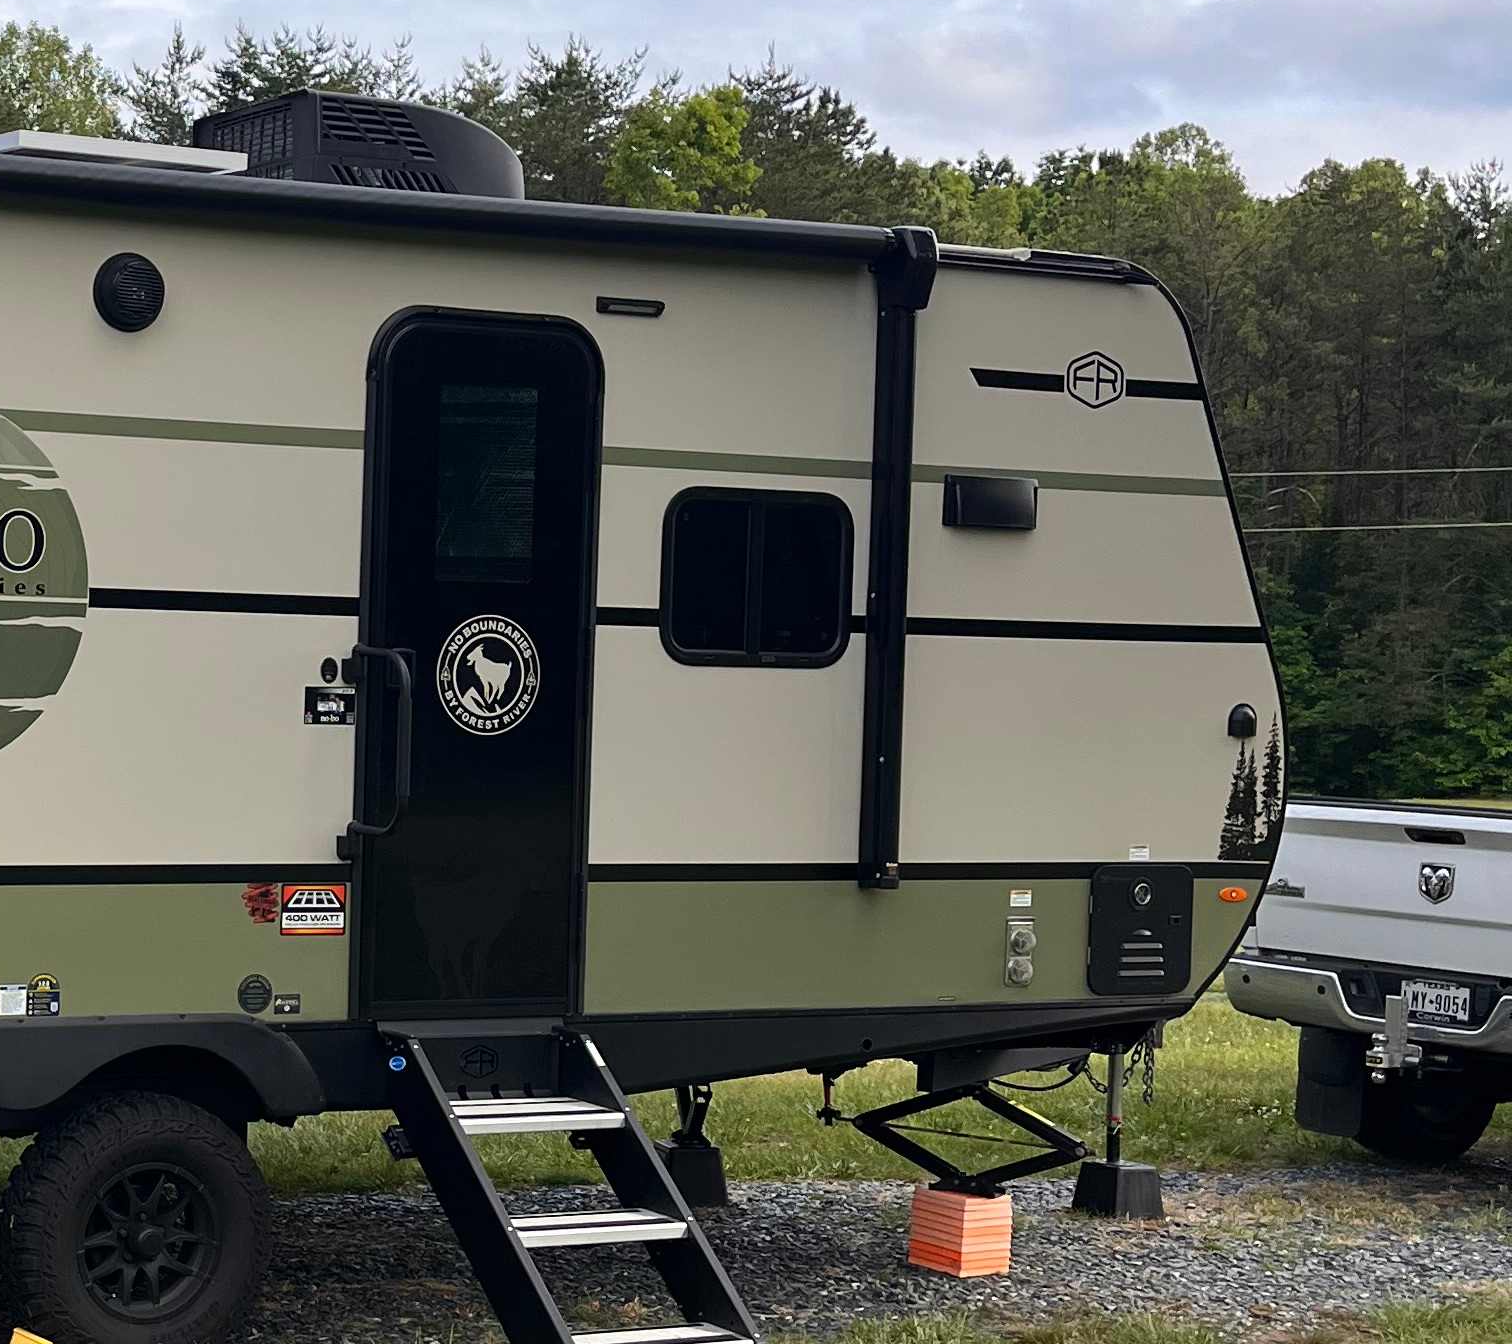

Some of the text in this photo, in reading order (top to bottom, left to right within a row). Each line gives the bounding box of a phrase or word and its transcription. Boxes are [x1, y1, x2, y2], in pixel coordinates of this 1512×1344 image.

[448, 620, 533, 659] NO BOUNDARIES
[444, 689, 531, 730] BY FOREST RIVER
[285, 914, 341, 922] 400 WATT
